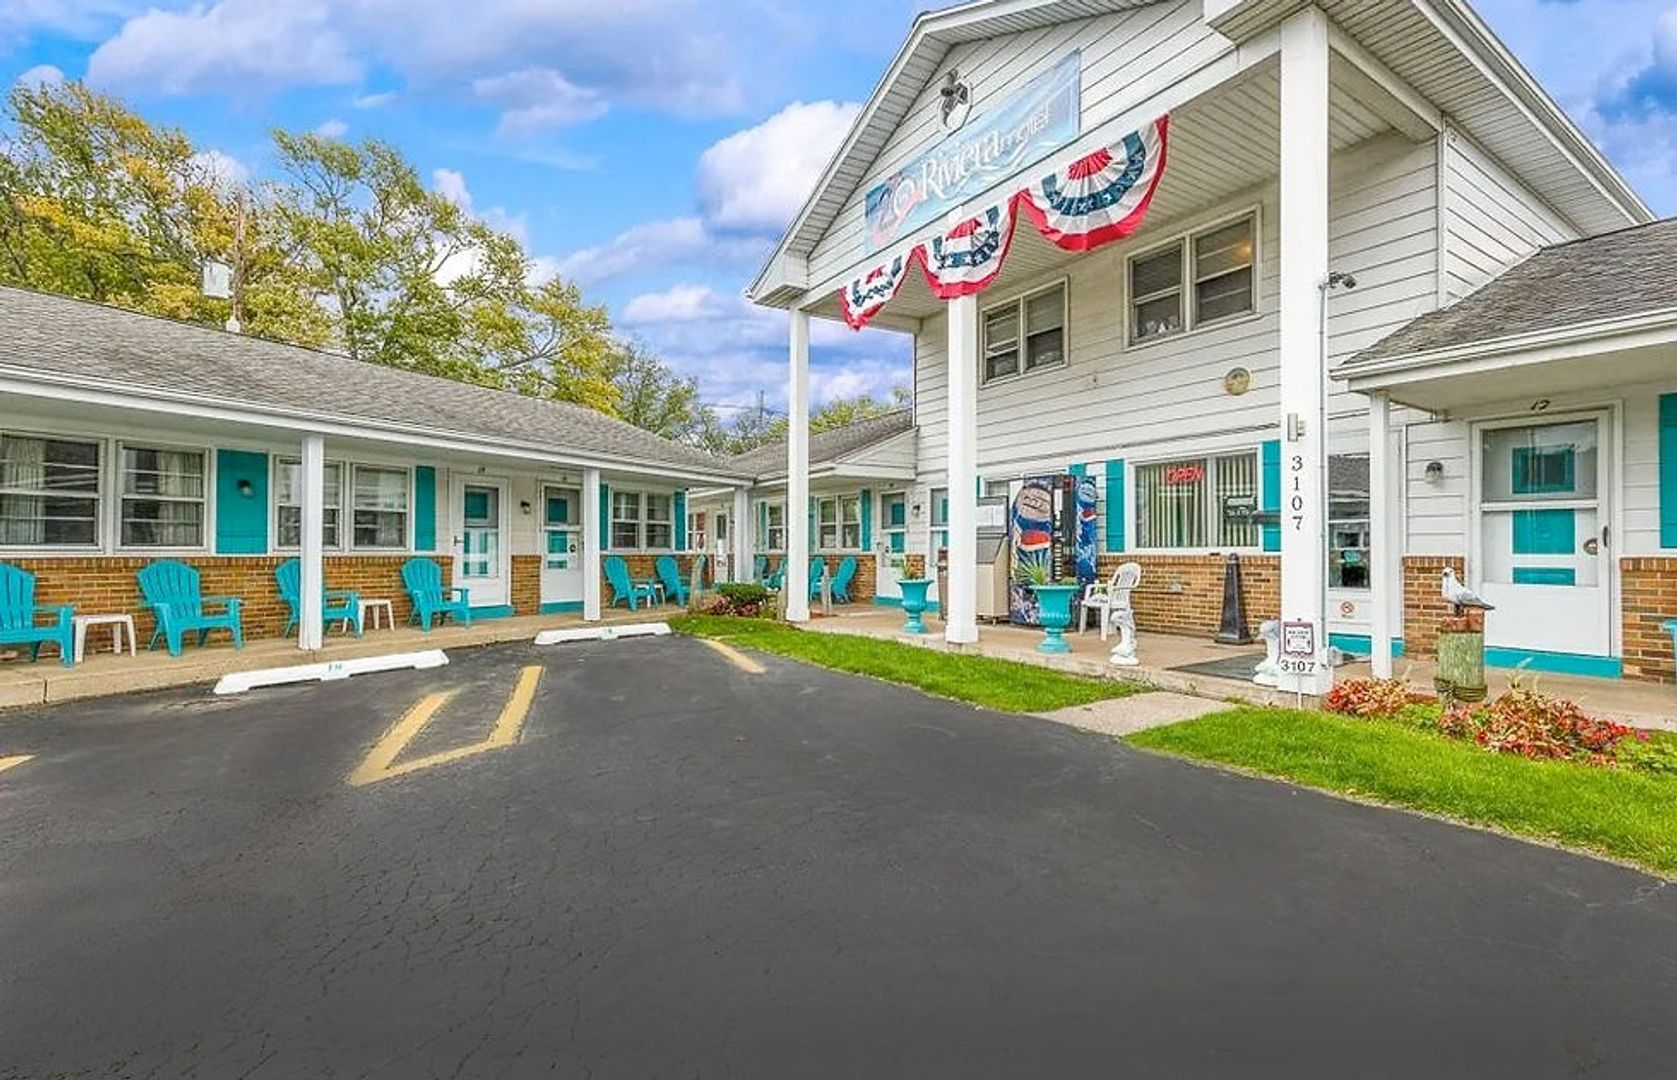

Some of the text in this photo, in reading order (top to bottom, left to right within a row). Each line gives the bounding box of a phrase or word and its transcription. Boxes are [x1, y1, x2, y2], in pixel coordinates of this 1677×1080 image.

[1165, 464, 1204, 485] OPEN
[1291, 455, 1303, 531] 3107
[1281, 660, 1316, 672] 3107
